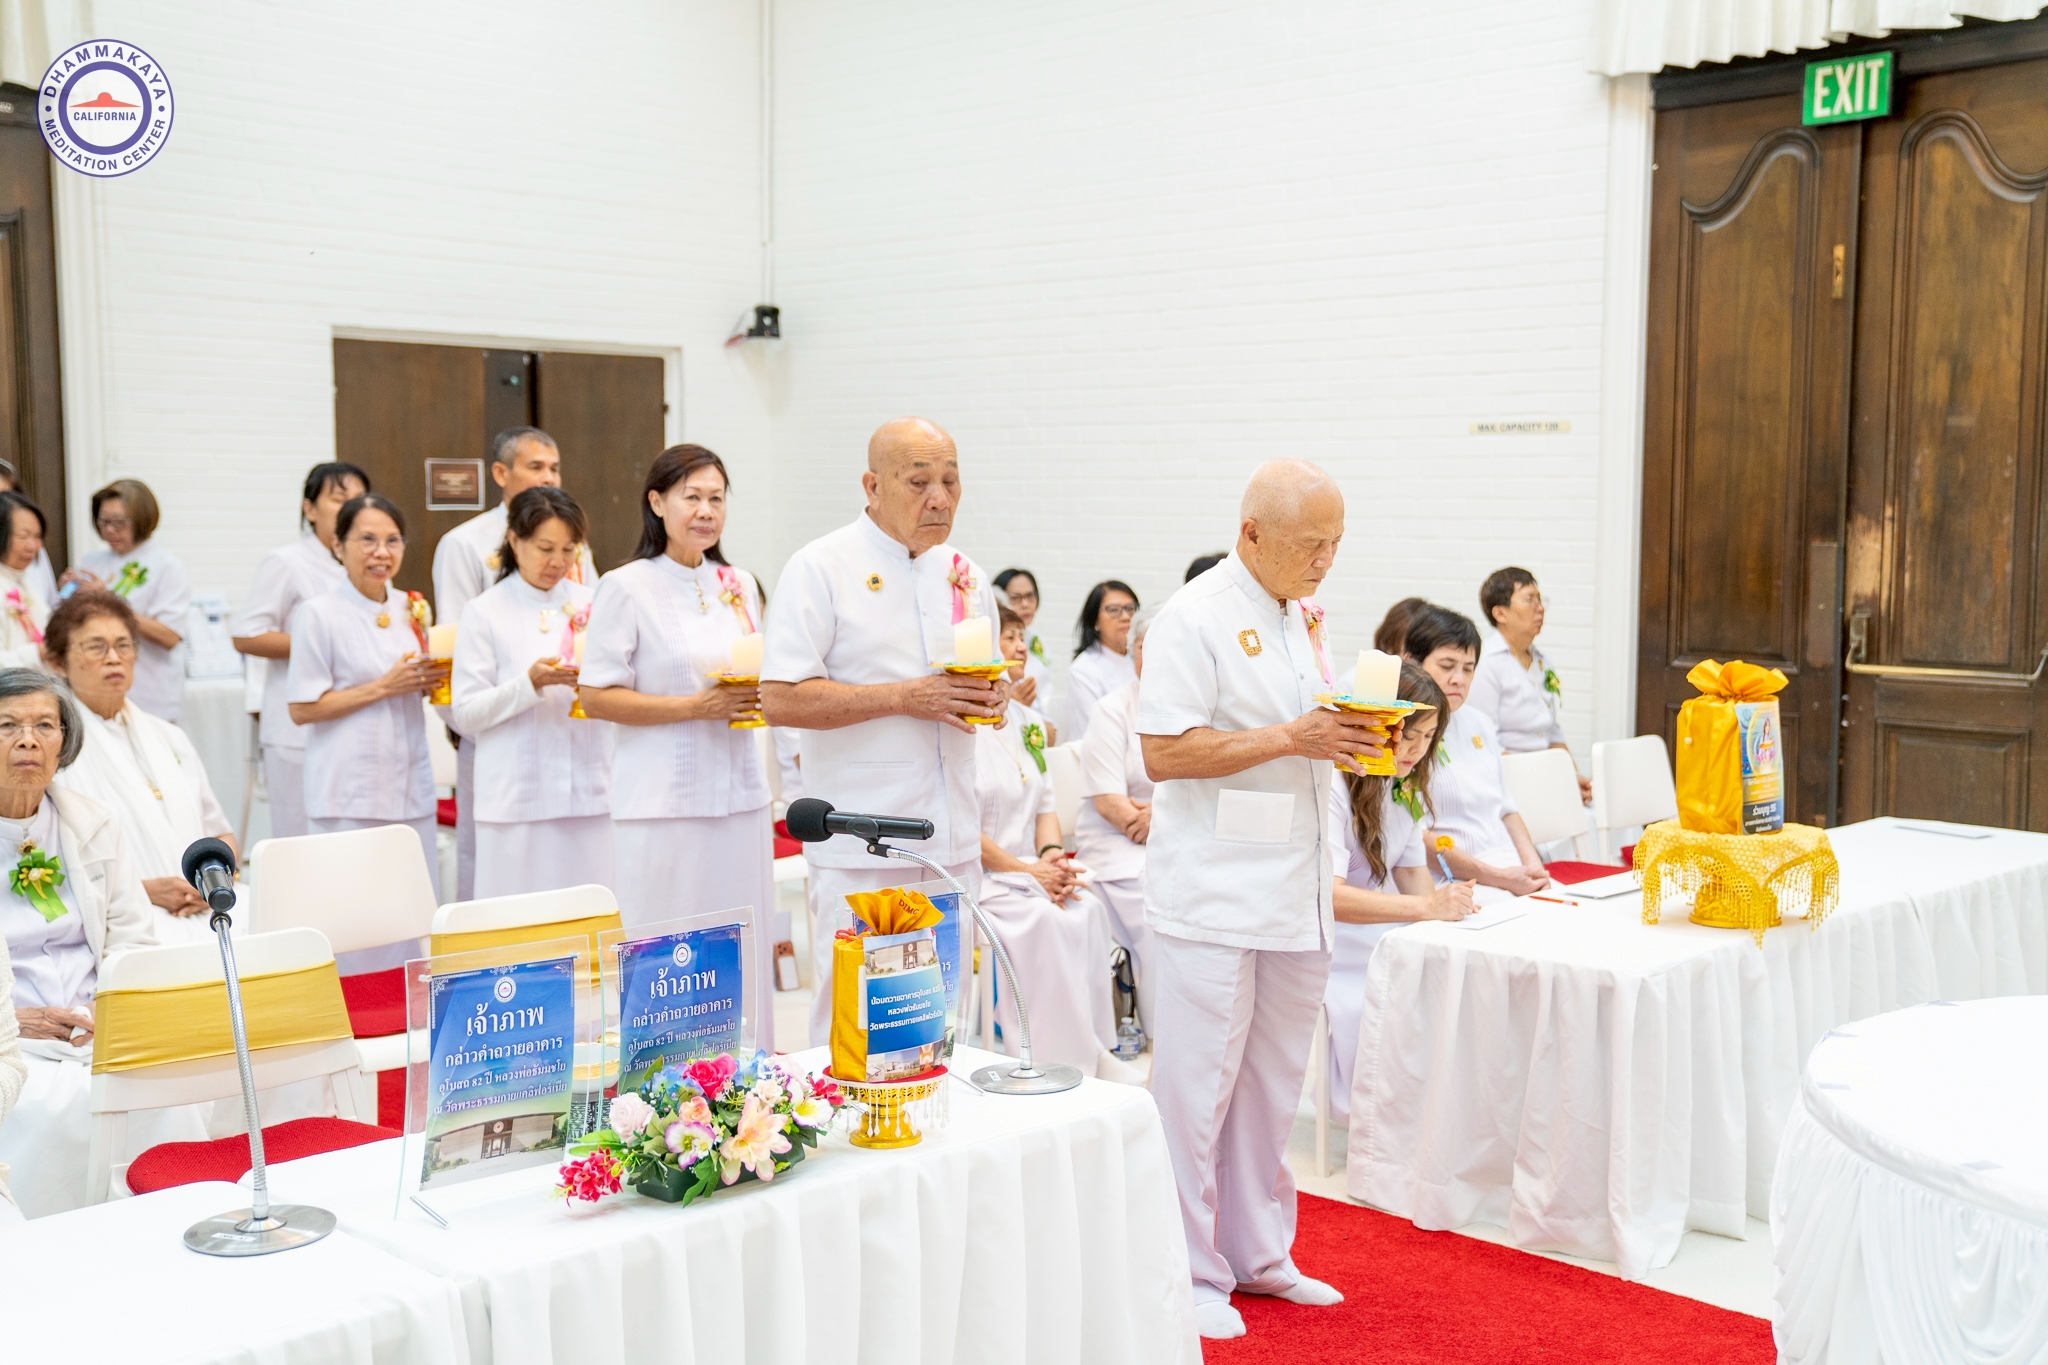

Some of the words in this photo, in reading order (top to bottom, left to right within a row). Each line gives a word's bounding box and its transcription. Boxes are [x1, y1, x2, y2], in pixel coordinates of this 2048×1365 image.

[1812, 58, 1885, 119] EXIT
[1477, 423, 1495, 433] MAX
[1499, 421, 1541, 432] CAPACITY
[650, 967, 716, 999] เจ้าภาพ
[466, 1002, 544, 1037] เจ้าภาพ
[633, 998, 733, 1028] กล่าวคำถวายอาคาร
[445, 1036, 563, 1068] กล่าวคำถวายอาคาร
[439, 1078, 470, 1096] อุโบสถ
[471, 1077, 483, 1086] 82
[484, 1070, 493, 1085] ปี
